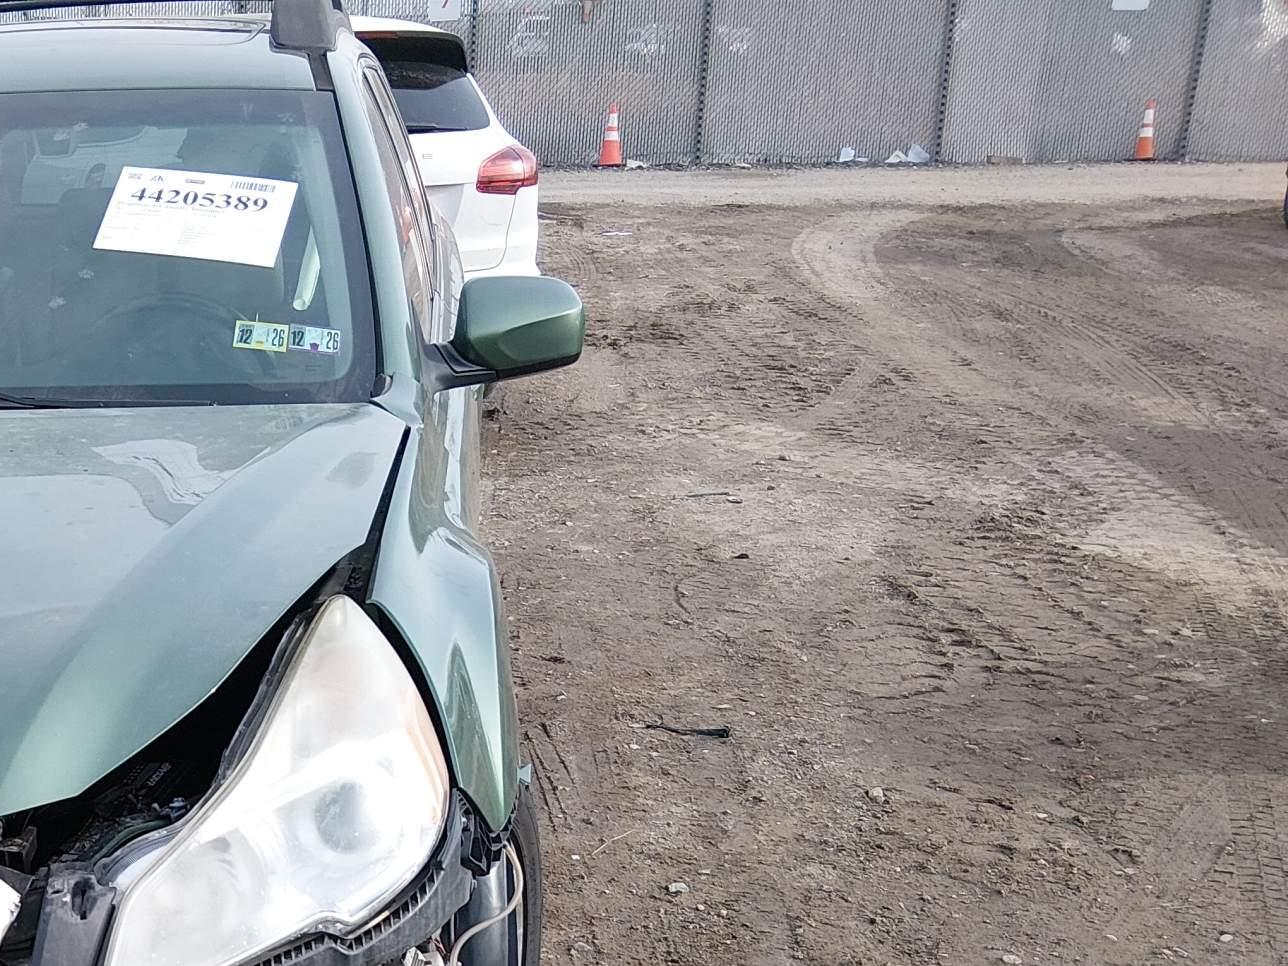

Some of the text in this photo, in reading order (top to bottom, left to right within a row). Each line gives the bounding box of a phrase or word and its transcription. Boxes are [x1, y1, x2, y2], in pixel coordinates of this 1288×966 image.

[130, 187, 269, 212] 44205389
[239, 327, 285, 347] 12 26
[291, 330, 339, 350] 12 26
